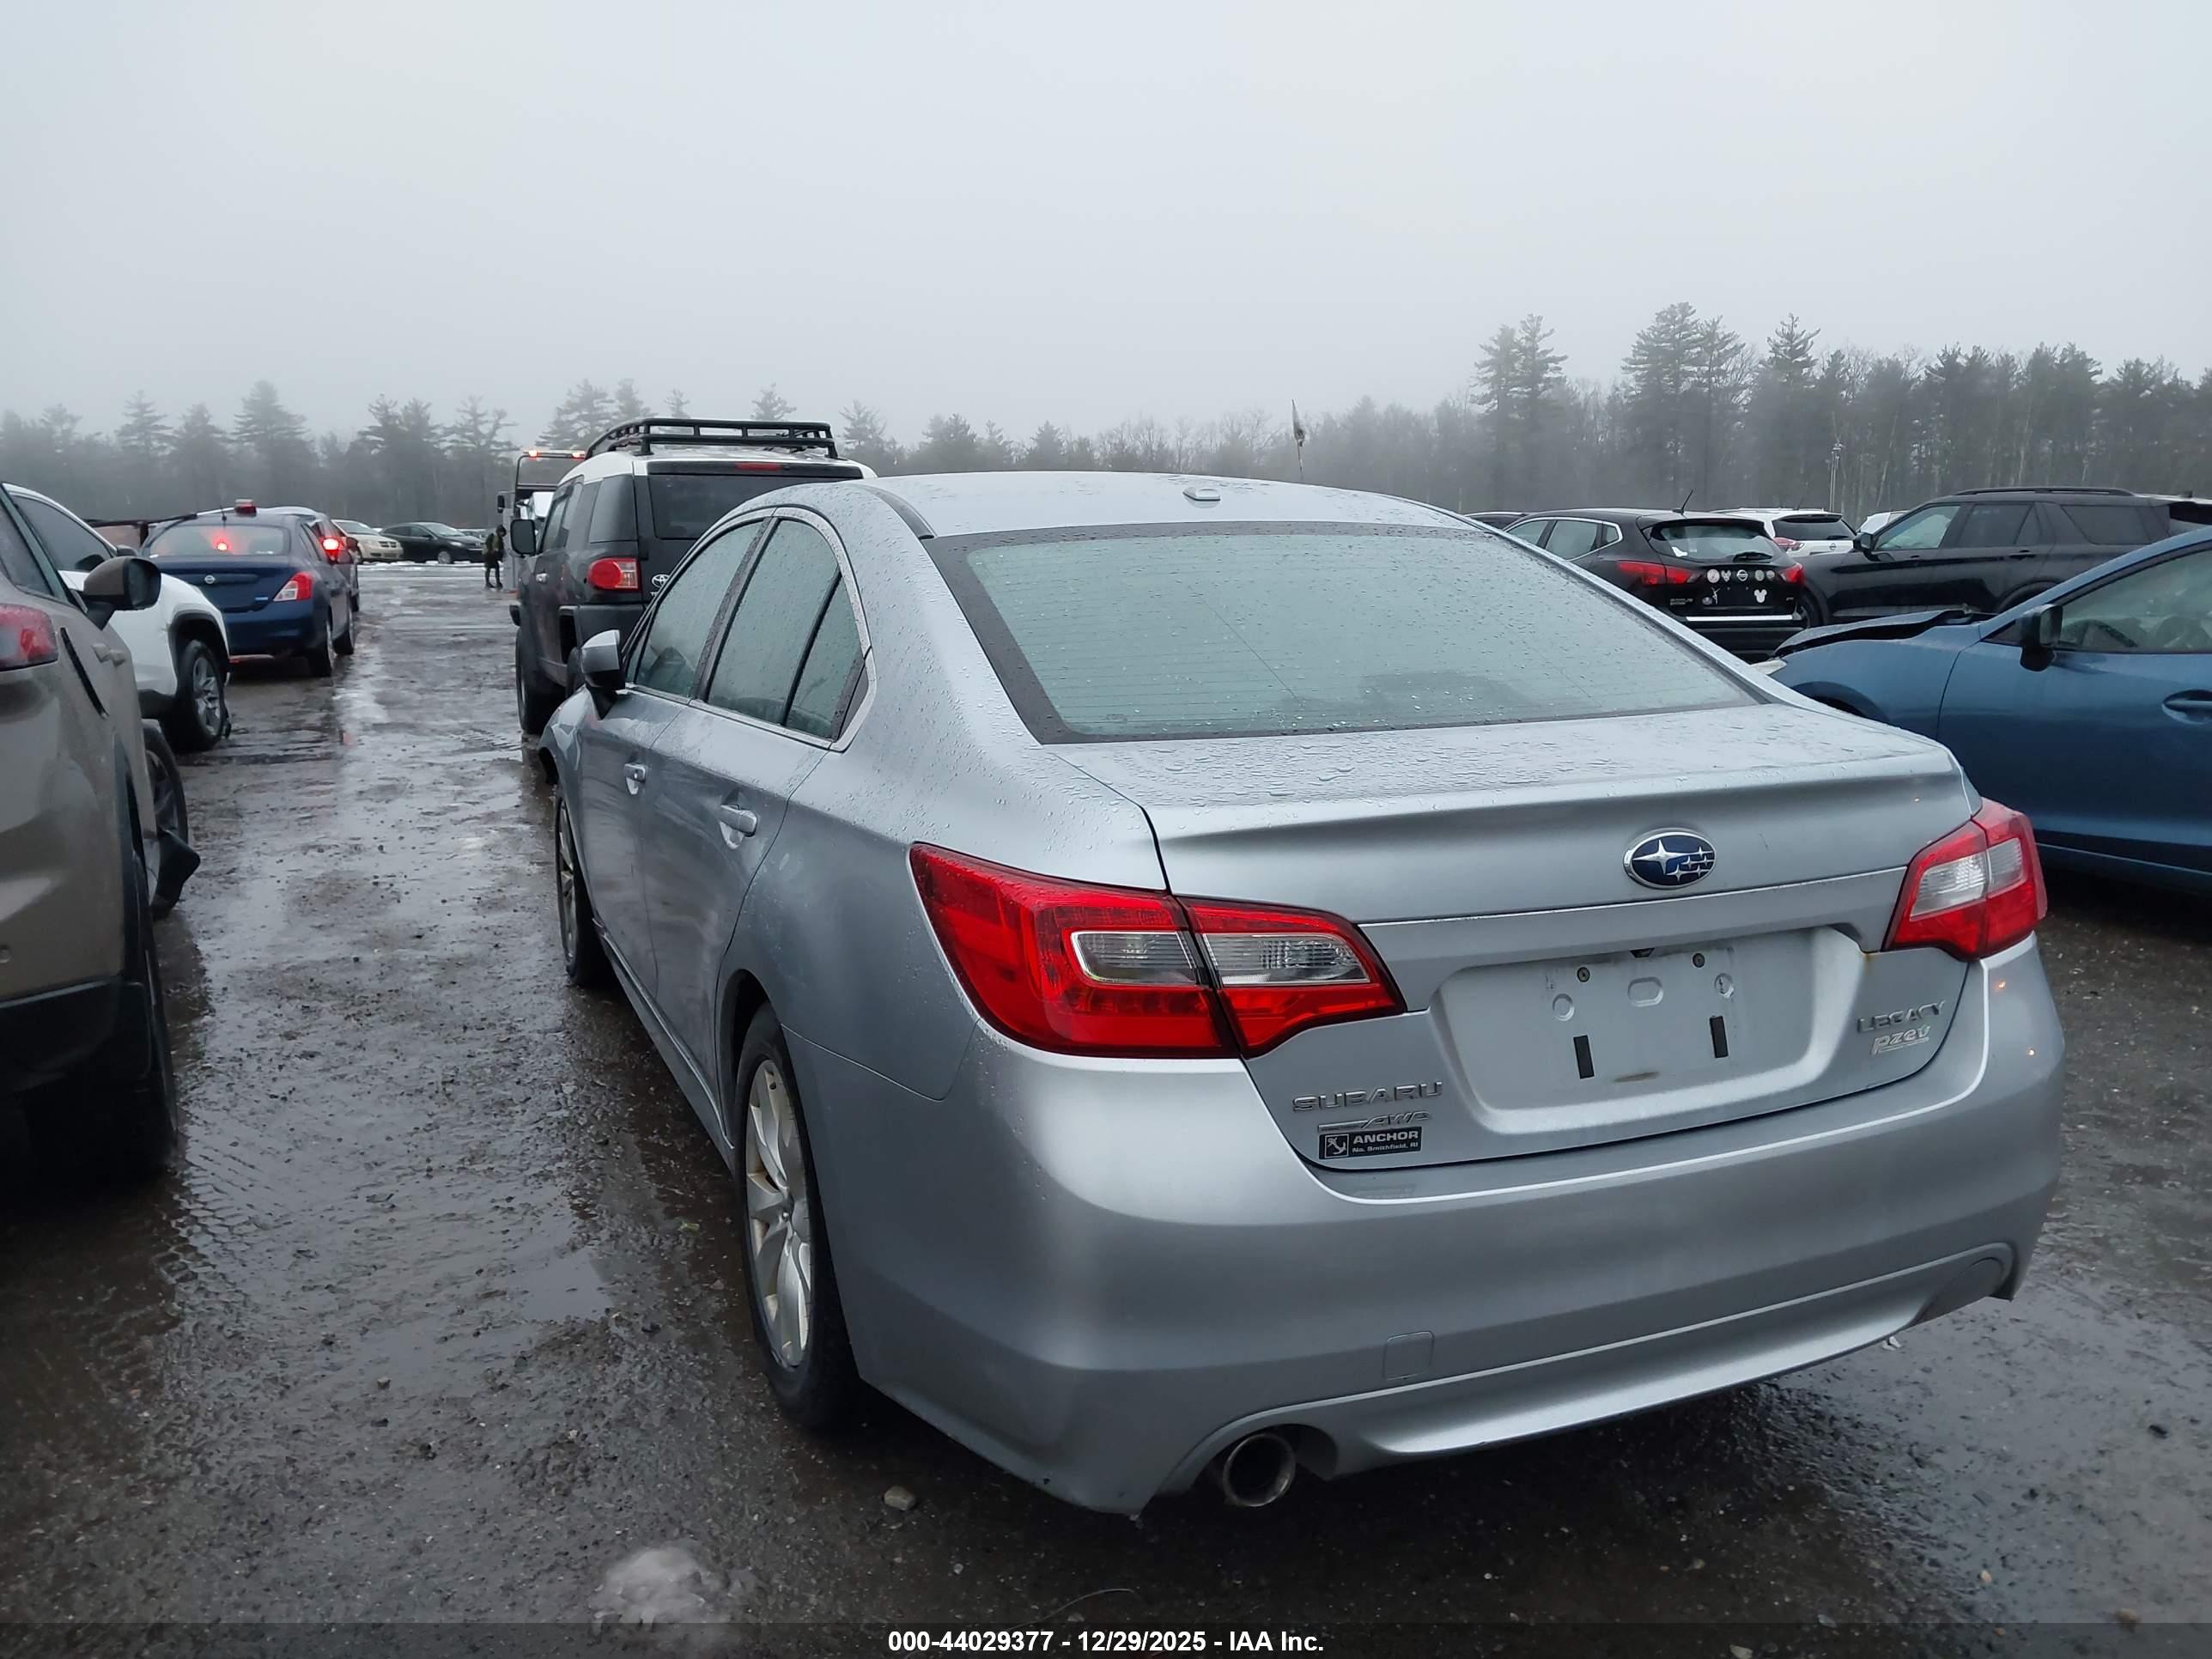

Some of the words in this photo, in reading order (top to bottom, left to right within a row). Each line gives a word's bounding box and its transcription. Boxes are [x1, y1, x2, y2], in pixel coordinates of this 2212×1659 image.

[1857, 1000, 1946, 1032] LEGACY
[1292, 1081, 1443, 1111] SUBARU
[1352, 1130, 1419, 1145] ANCHOR
